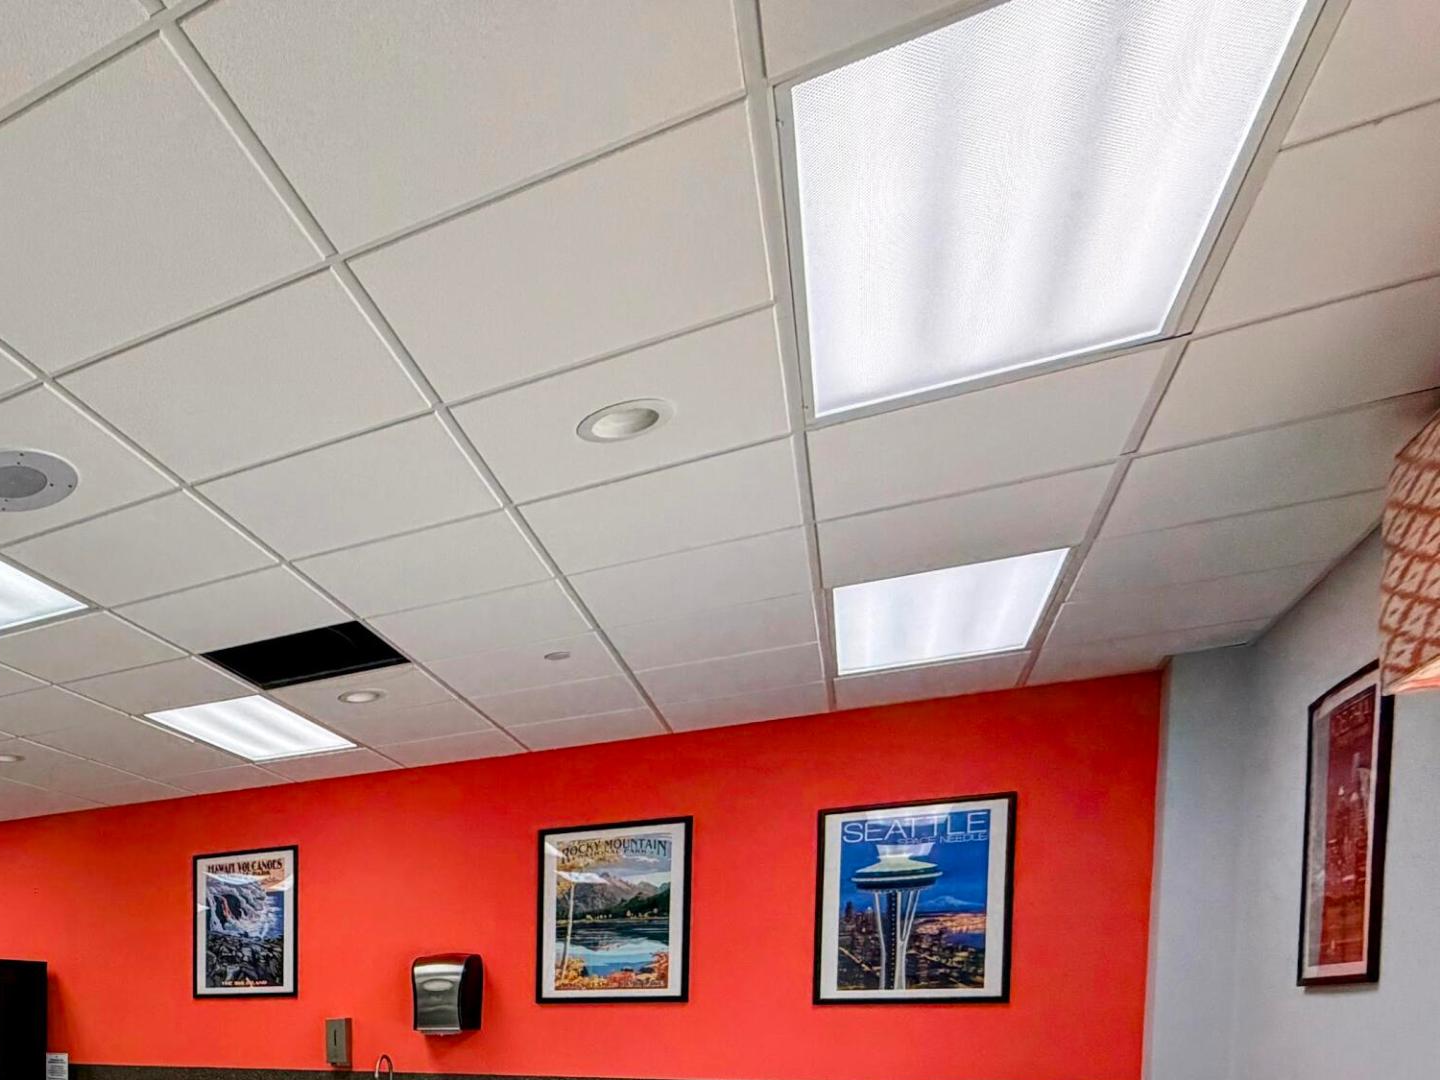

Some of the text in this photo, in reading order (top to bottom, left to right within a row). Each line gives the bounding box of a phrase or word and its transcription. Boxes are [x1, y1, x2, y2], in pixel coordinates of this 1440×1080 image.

[843, 811, 987, 843] SEATTLE
[939, 832, 987, 843] NEEDLE
[561, 838, 667, 864] ROCKY MOUNTAIN
[237, 859, 282, 873] VOLCANOES
